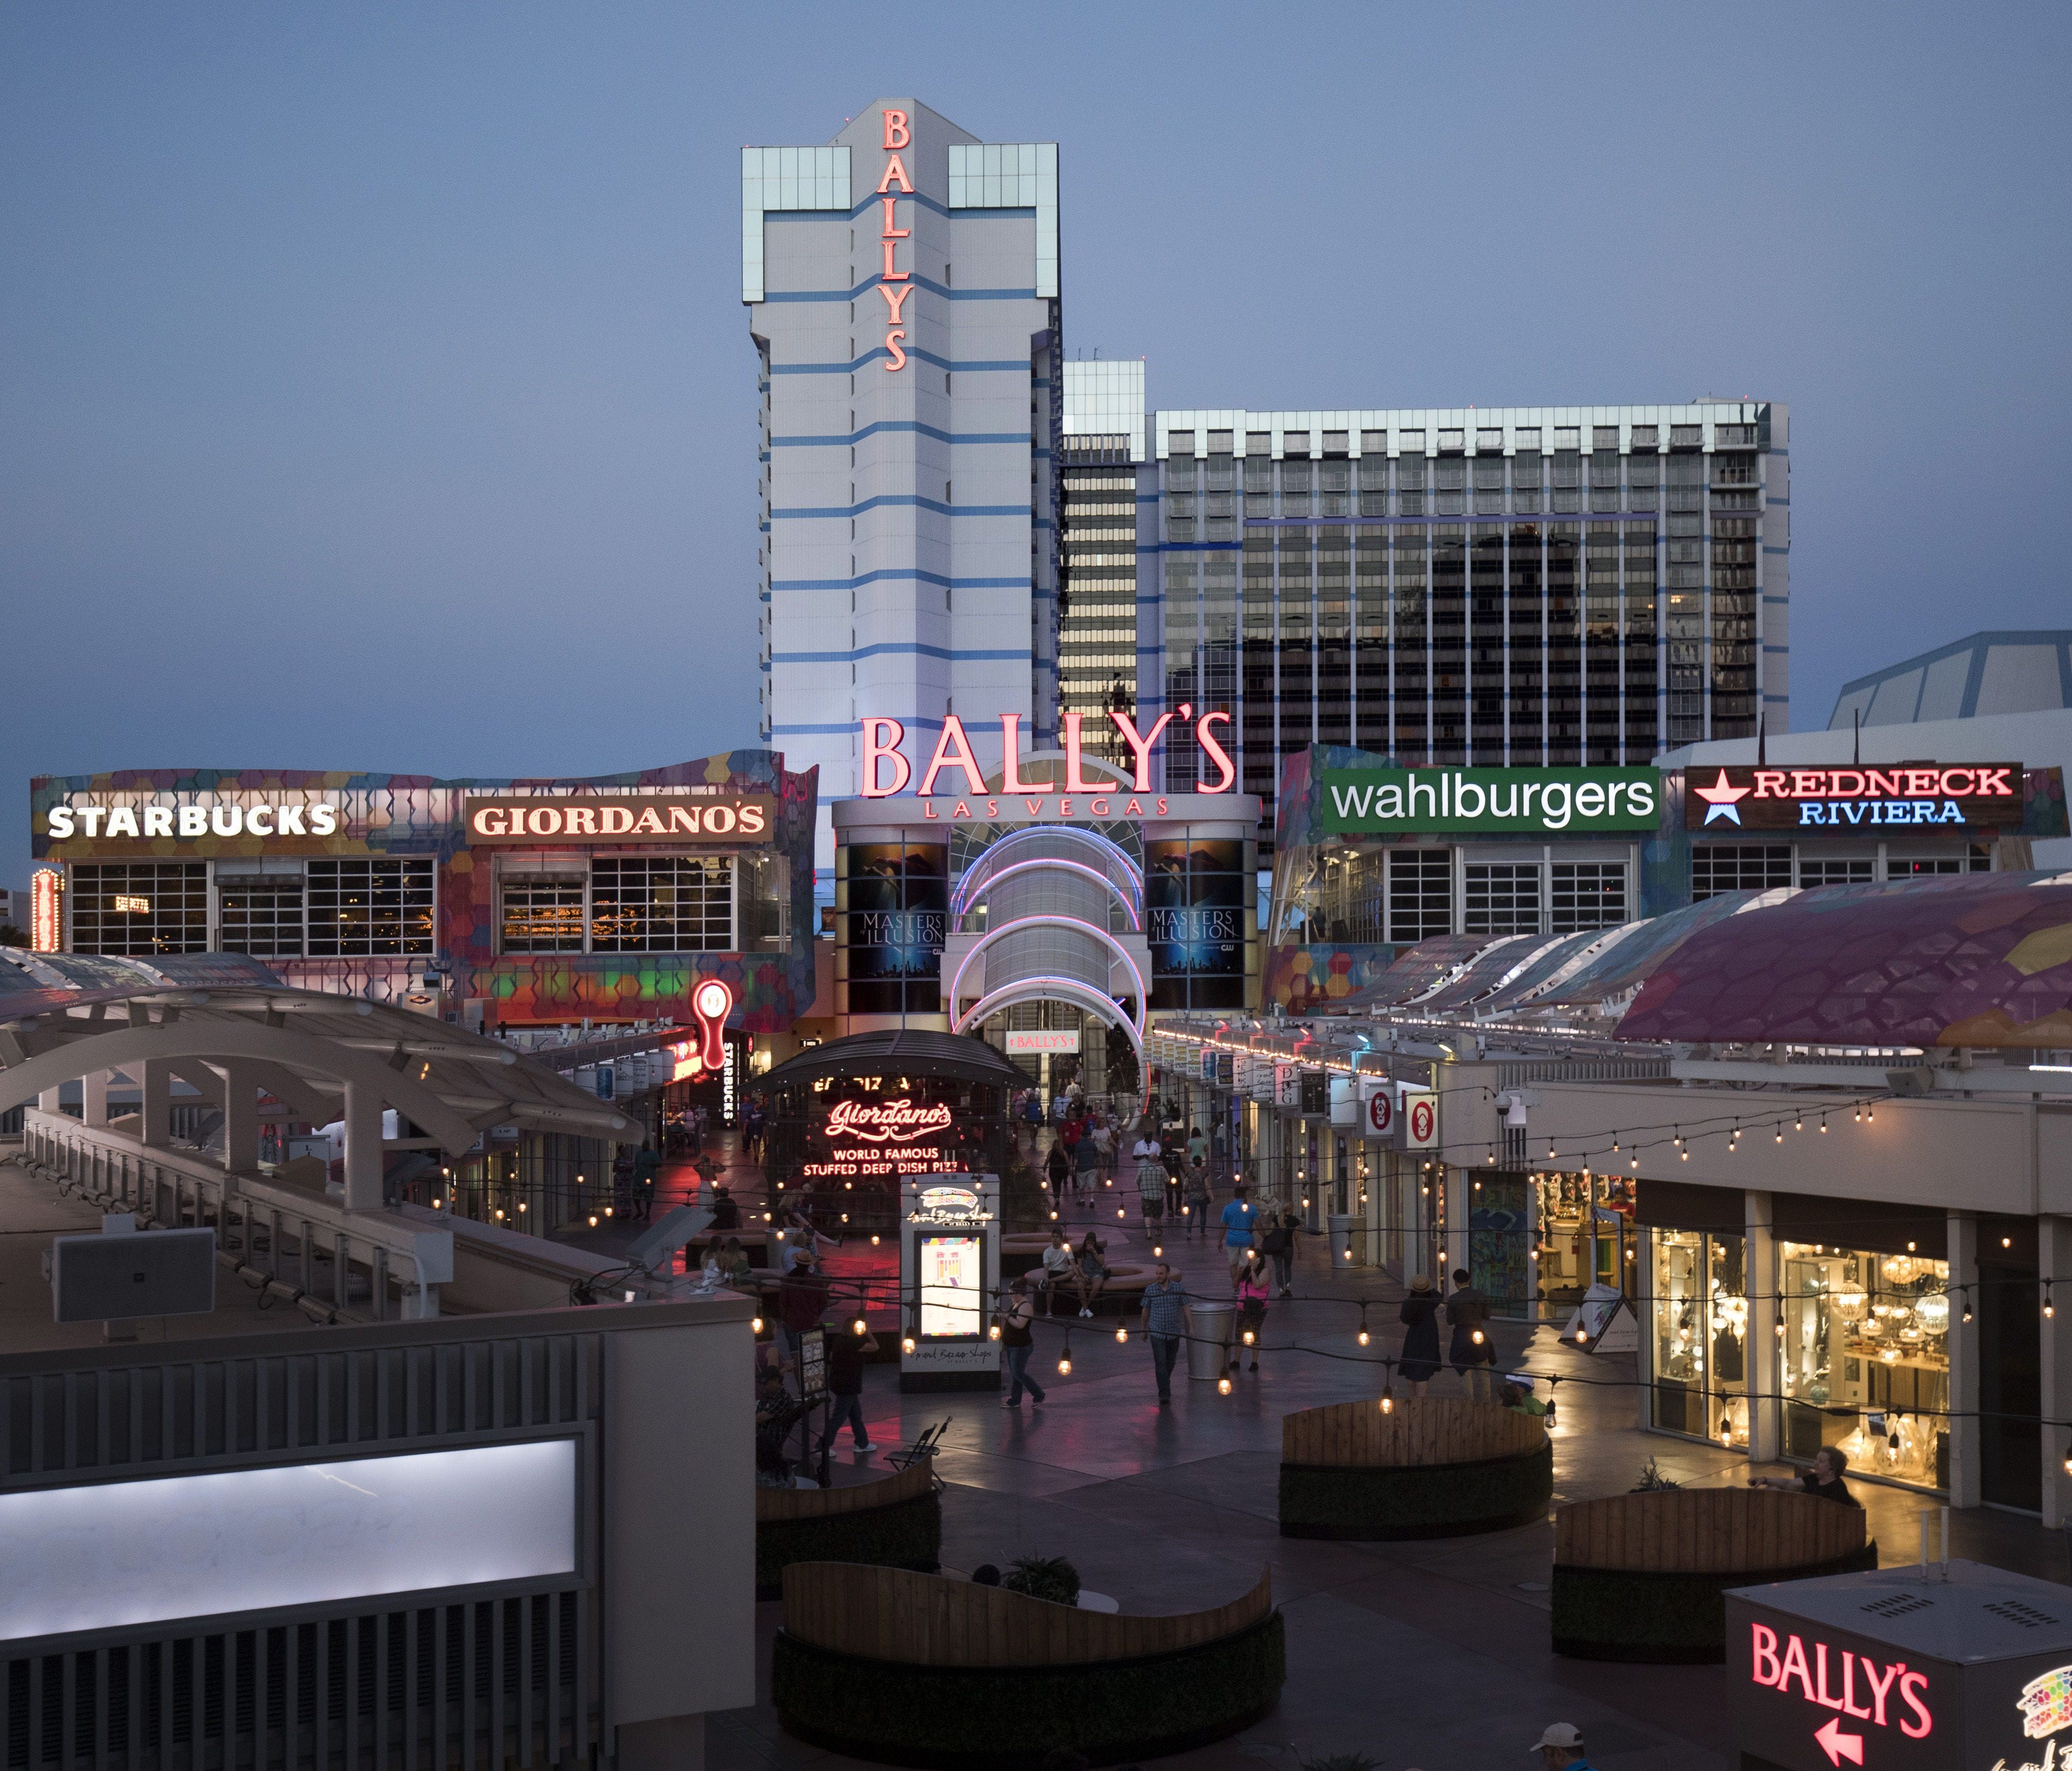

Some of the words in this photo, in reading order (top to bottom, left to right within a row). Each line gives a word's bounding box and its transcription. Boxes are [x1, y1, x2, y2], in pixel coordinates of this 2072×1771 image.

[860, 703, 1235, 798] BALLY'S
[1754, 768, 2013, 799] REDNECK
[924, 800, 999, 819] LAS
[1026, 797, 1168, 817] VEGAS
[1331, 773, 1654, 829] wahlburgers
[49, 804, 336, 838] STARBUCKS
[473, 801, 765, 836] GIORDANO'S
[1799, 801, 1966, 825] RIVIERA
[863, 913, 941, 929] MASTERS
[1153, 910, 1233, 926] MASTERS
[868, 929, 944, 945] ILLUSION
[1157, 925, 1240, 942] ILLUSION
[1017, 1035, 1068, 1049] BALLY'S
[723, 1042, 733, 1119] STARBUCKS
[825, 1099, 951, 1141] Giordano's
[833, 1149, 880, 1161] WORLD
[885, 1148, 939, 1159] FAMOUS
[803, 1164, 858, 1176] STUFFED
[862, 1163, 893, 1175] DEEP
[897, 1162, 927, 1173] DISH
[969, 1344, 992, 1364] Shops
[1752, 1623, 1932, 1739] BALLY'S
